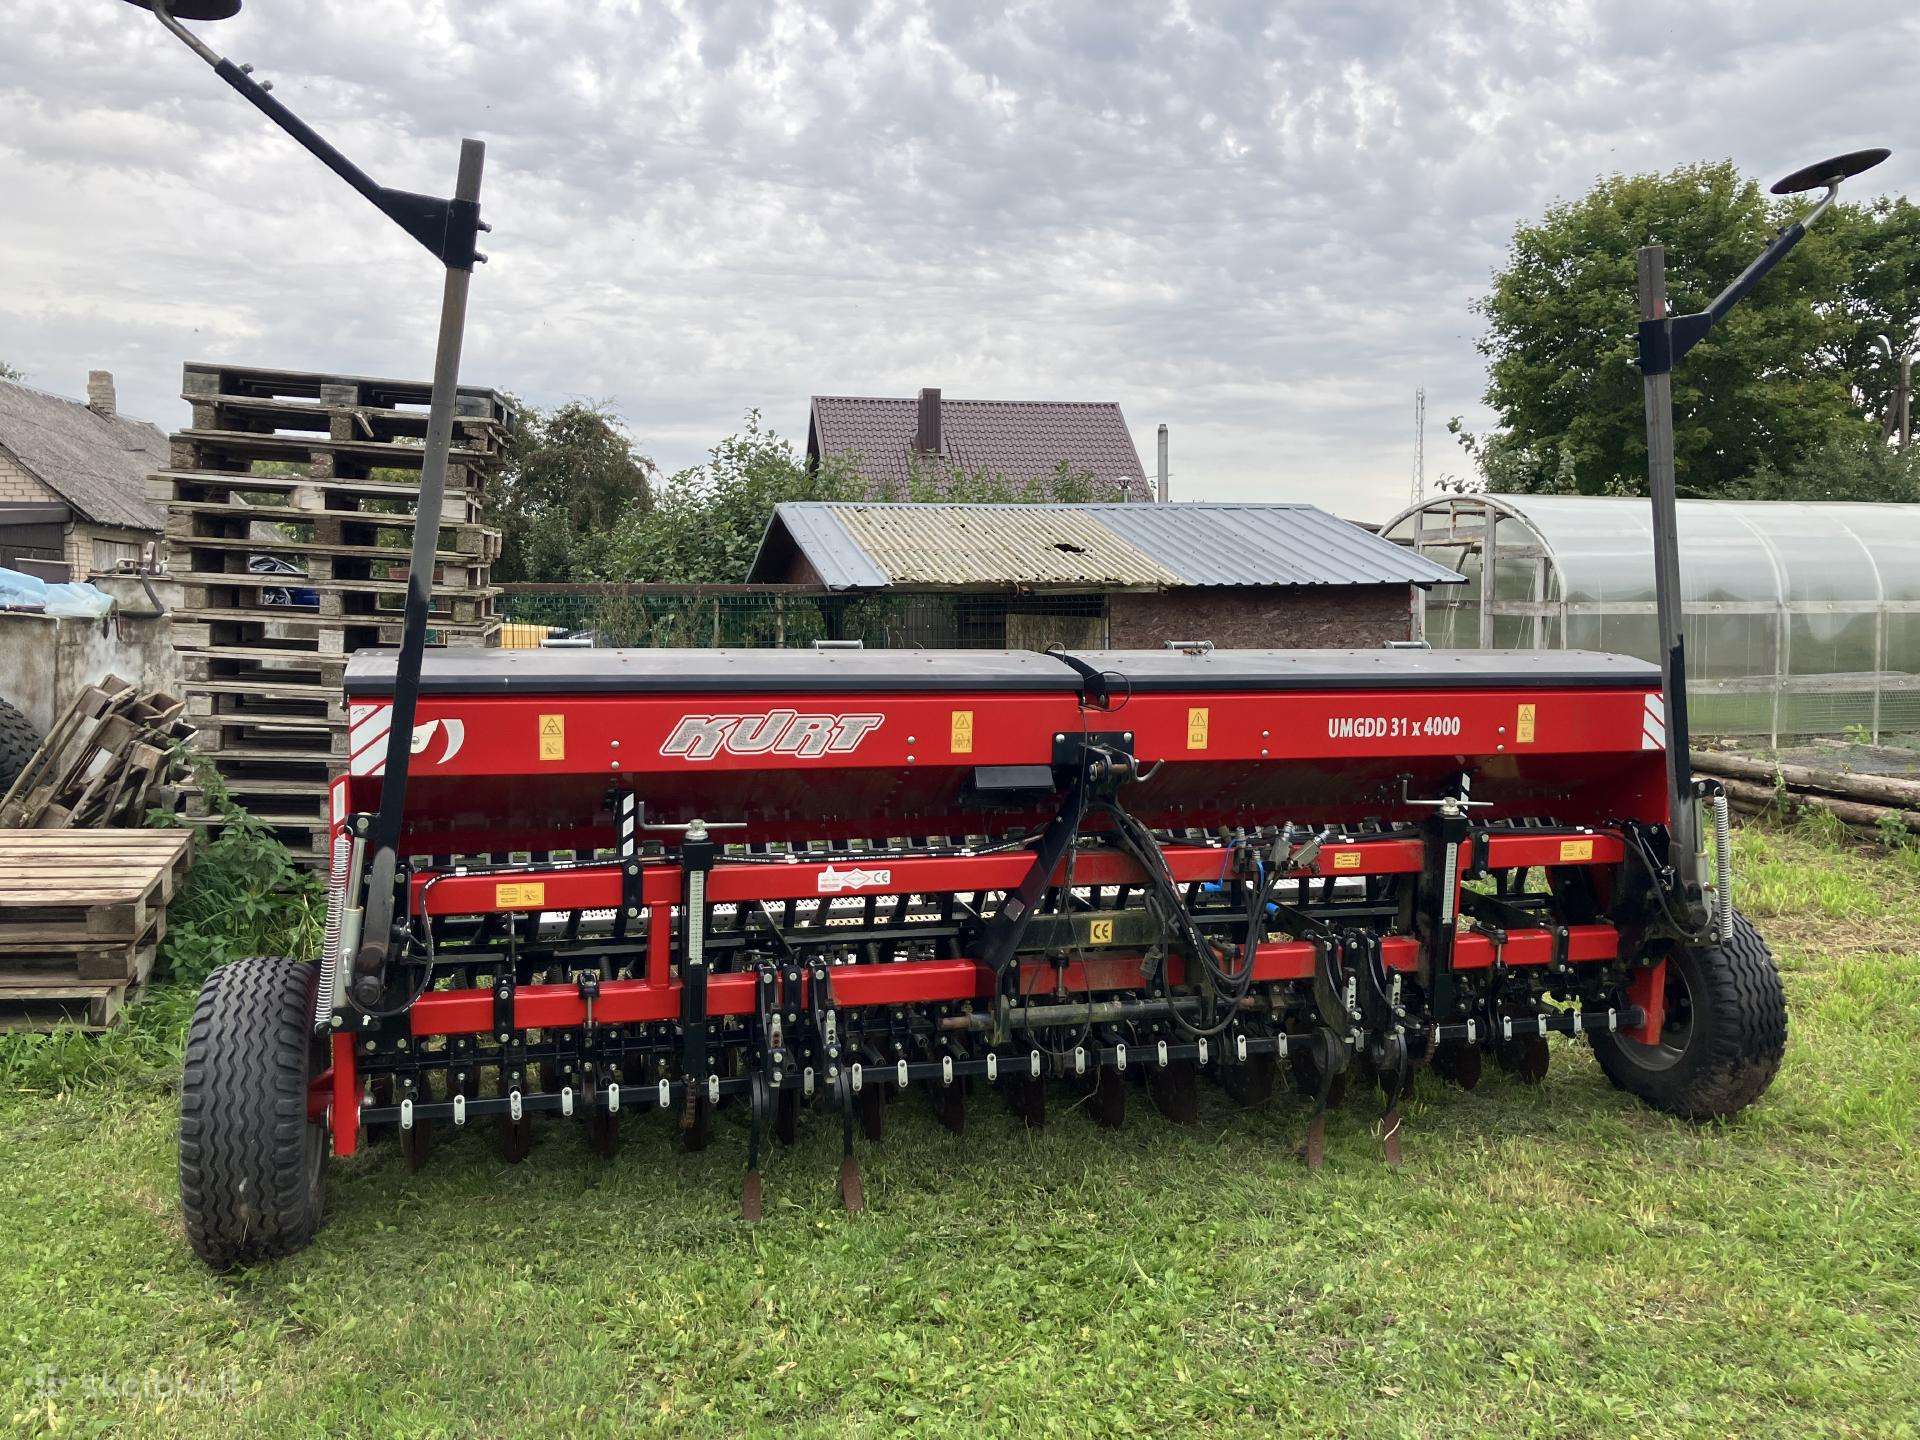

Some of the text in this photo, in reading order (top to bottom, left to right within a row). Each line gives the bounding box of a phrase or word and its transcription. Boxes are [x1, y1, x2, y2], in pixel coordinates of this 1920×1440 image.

[659, 709, 885, 760] KURT
[1328, 716, 1461, 738] UMGDD 31 x 4000
[1093, 923, 1109, 939] CE
